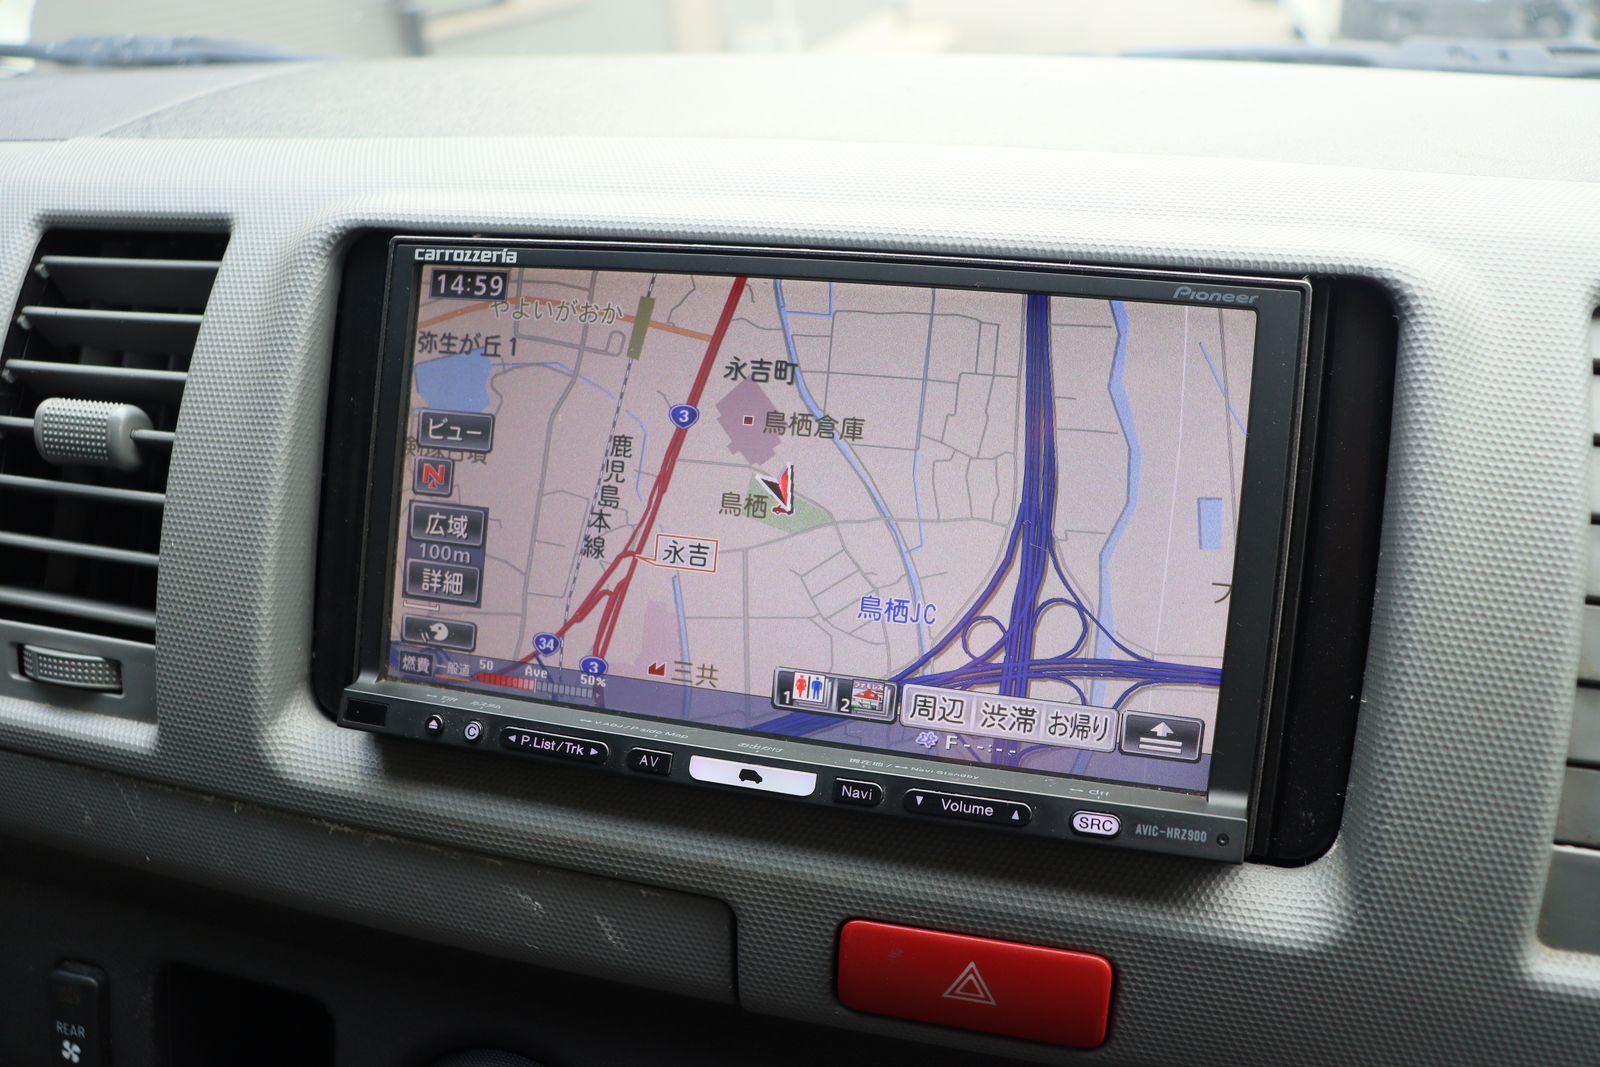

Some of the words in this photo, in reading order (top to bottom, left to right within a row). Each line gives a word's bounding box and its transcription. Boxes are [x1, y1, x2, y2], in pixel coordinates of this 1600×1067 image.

[414, 248, 517, 263] carrozzeria
[437, 273, 503, 297] 14:59
[1173, 286, 1259, 304] Pioneer
[490, 299, 622, 325] やよいがおか
[723, 356, 798, 386] 永吉町
[679, 410, 689, 423] 3
[763, 410, 866, 441] 鳥栖倉庫
[428, 418, 482, 441] ビュー
[583, 434, 634, 559] 鹿児島本線
[718, 491, 769, 519] 鳥栖
[425, 513, 469, 539] 広域
[419, 543, 471, 564] 100m
[662, 540, 711, 568] 永吉
[421, 568, 464, 595] 詳細
[857, 595, 938, 626] 鳥栖JC
[538, 636, 555, 652] 34
[402, 656, 430, 673] 燃費
[436, 660, 470, 677] 一般道
[479, 659, 494, 671] 50
[524, 665, 548, 680] Ave
[588, 661, 599, 674] 3
[580, 674, 607, 688] 50%
[671, 660, 719, 689] 三共
[855, 681, 884, 691] ファミレス
[784, 691, 791, 704] 1
[840, 698, 850, 713] 2
[909, 694, 964, 724] 周辺
[980, 702, 1037, 734] 渋滞
[1048, 711, 1109, 742] お帰り
[520, 735, 585, 756] P.List/Trk
[639, 755, 659, 767] AV
[841, 785, 873, 800] Navi
[941, 798, 994, 816] Volume
[1078, 816, 1114, 832] SRC
[1135, 823, 1207, 843] AVIC-HRZ900
[56, 1020, 86, 1039] REAR
